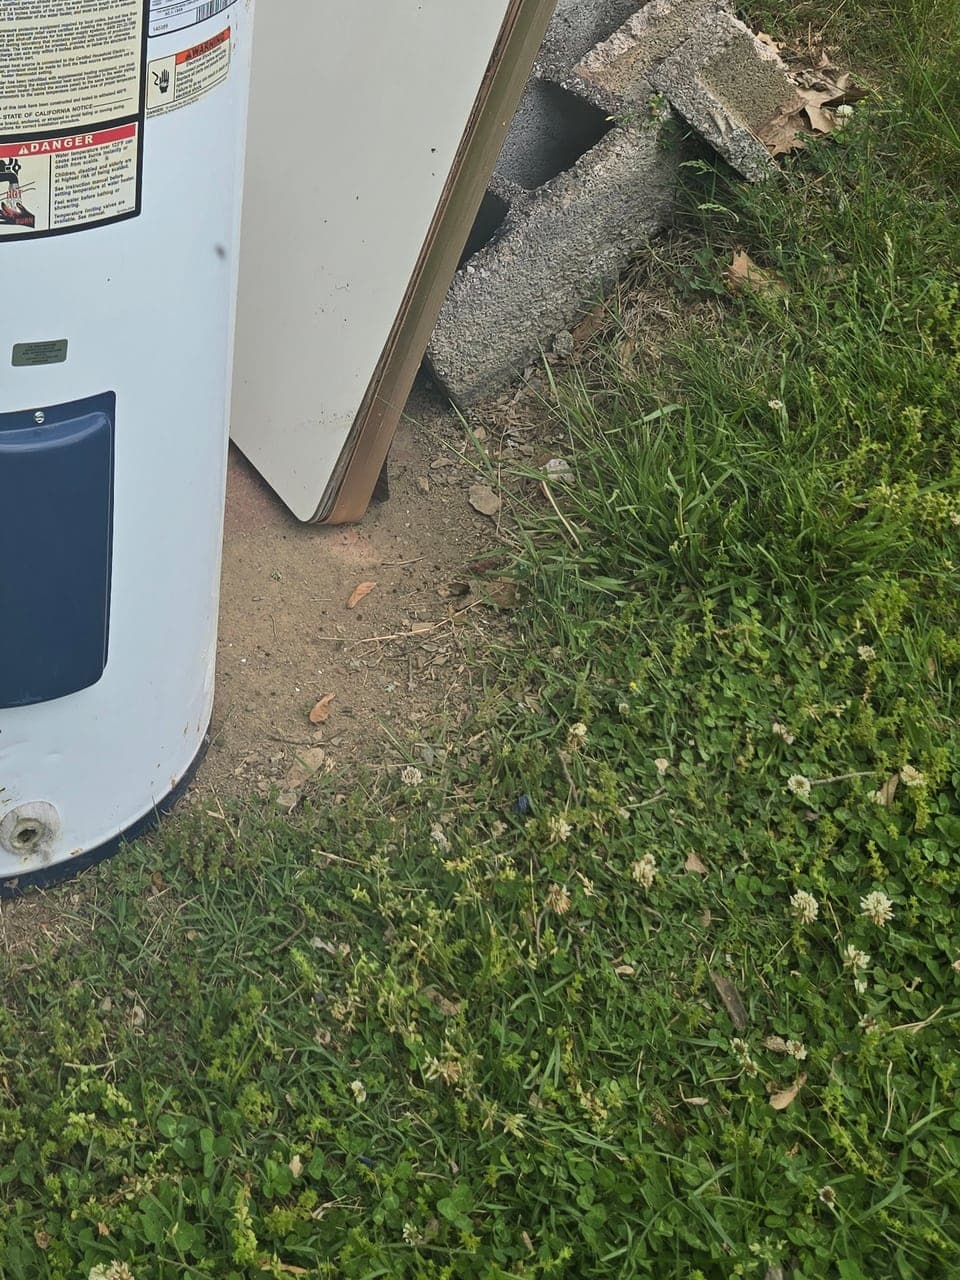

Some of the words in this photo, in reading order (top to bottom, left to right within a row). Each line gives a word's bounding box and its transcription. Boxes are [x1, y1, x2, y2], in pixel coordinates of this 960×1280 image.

[35, 108, 70, 117] CALIFORNIA
[72, 104, 93, 112] NOTICE
[30, 135, 94, 153] DANGER
[7, 189, 22, 199] HOT
